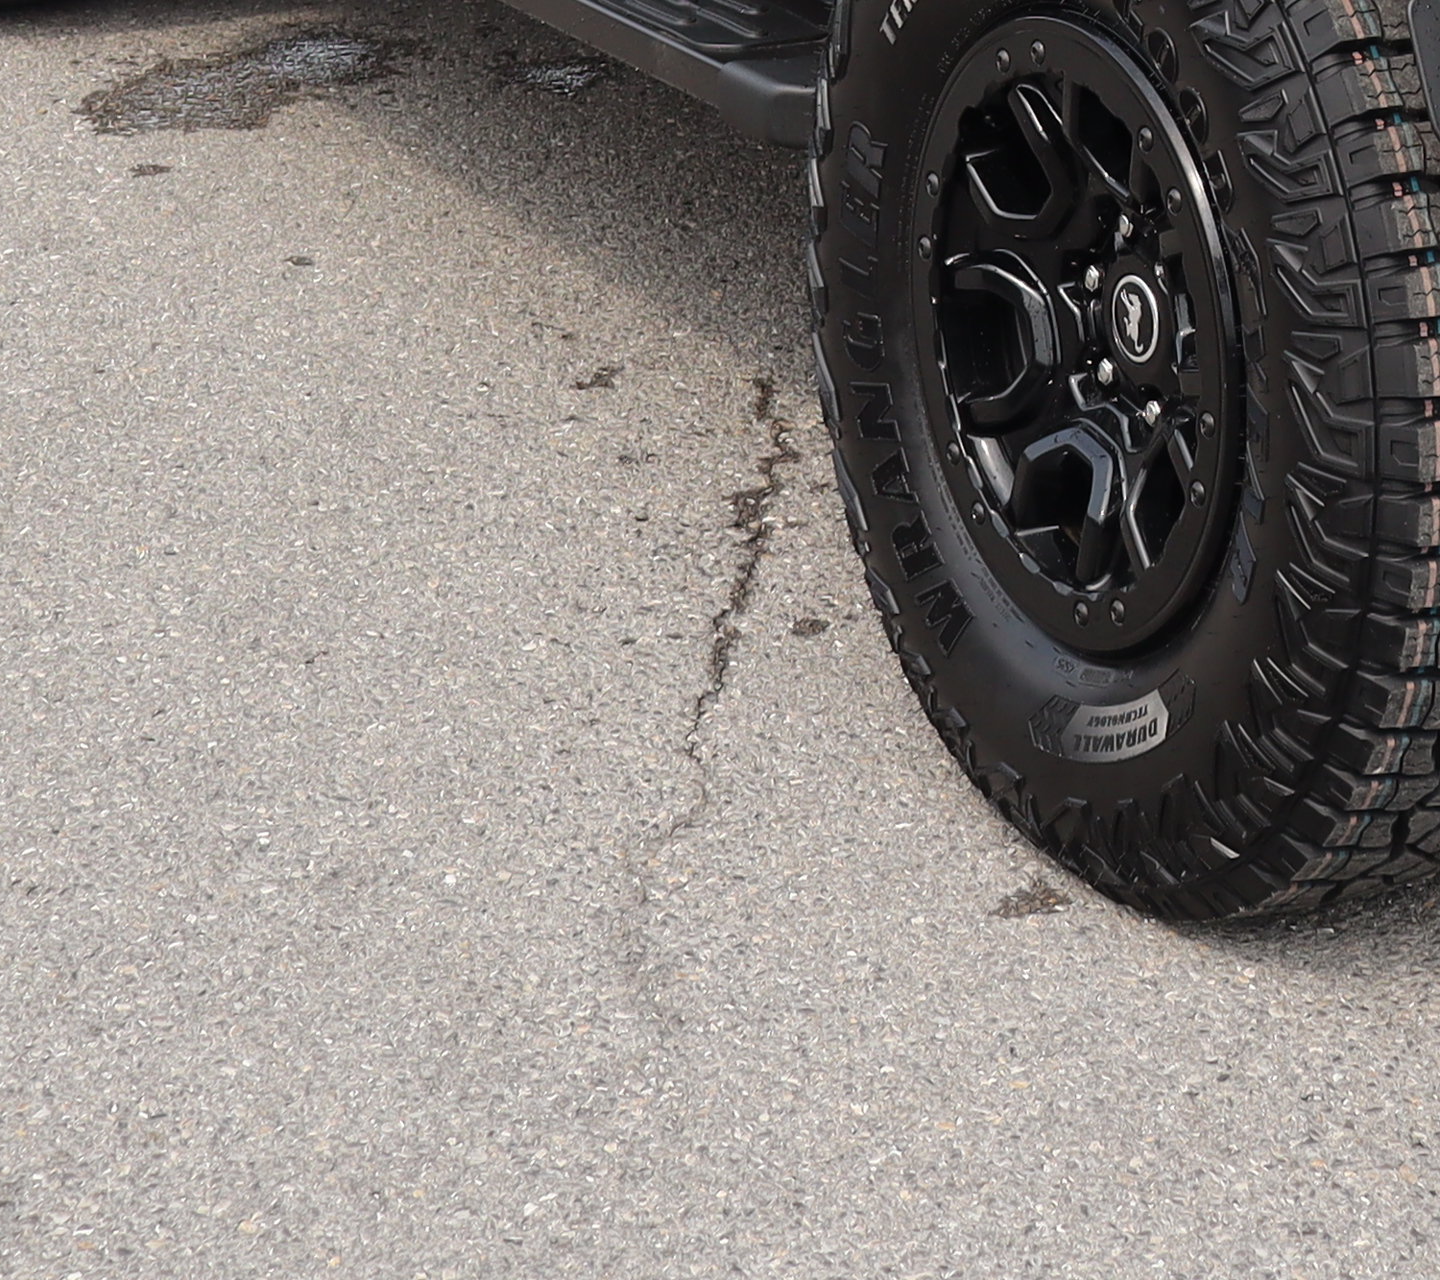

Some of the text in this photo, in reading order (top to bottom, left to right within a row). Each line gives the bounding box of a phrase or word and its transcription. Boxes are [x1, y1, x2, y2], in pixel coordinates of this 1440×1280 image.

[838, 120, 975, 657] WRANGLER
[1073, 716, 1159, 753] DURAWALL
[1087, 704, 1149, 728] TECHNOLOGY
